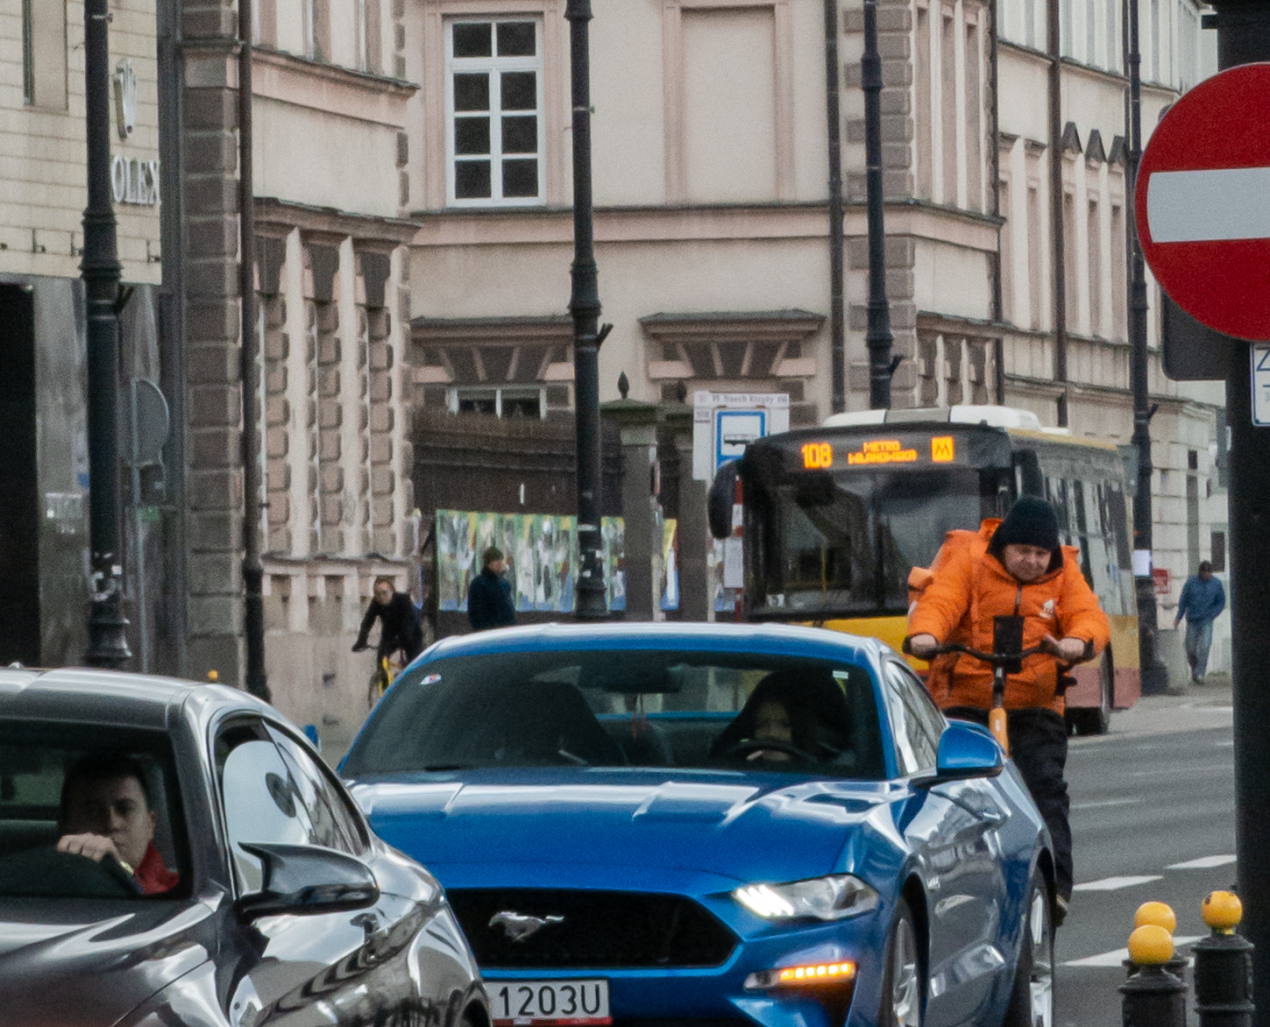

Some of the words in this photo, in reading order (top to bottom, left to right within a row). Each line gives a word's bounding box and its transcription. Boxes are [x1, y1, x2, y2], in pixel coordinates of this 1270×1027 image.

[111, 155, 161, 205] OLEX
[801, 442, 833, 469] 108
[863, 439, 901, 452] METRO
[498, 983, 601, 1017] 1203U
